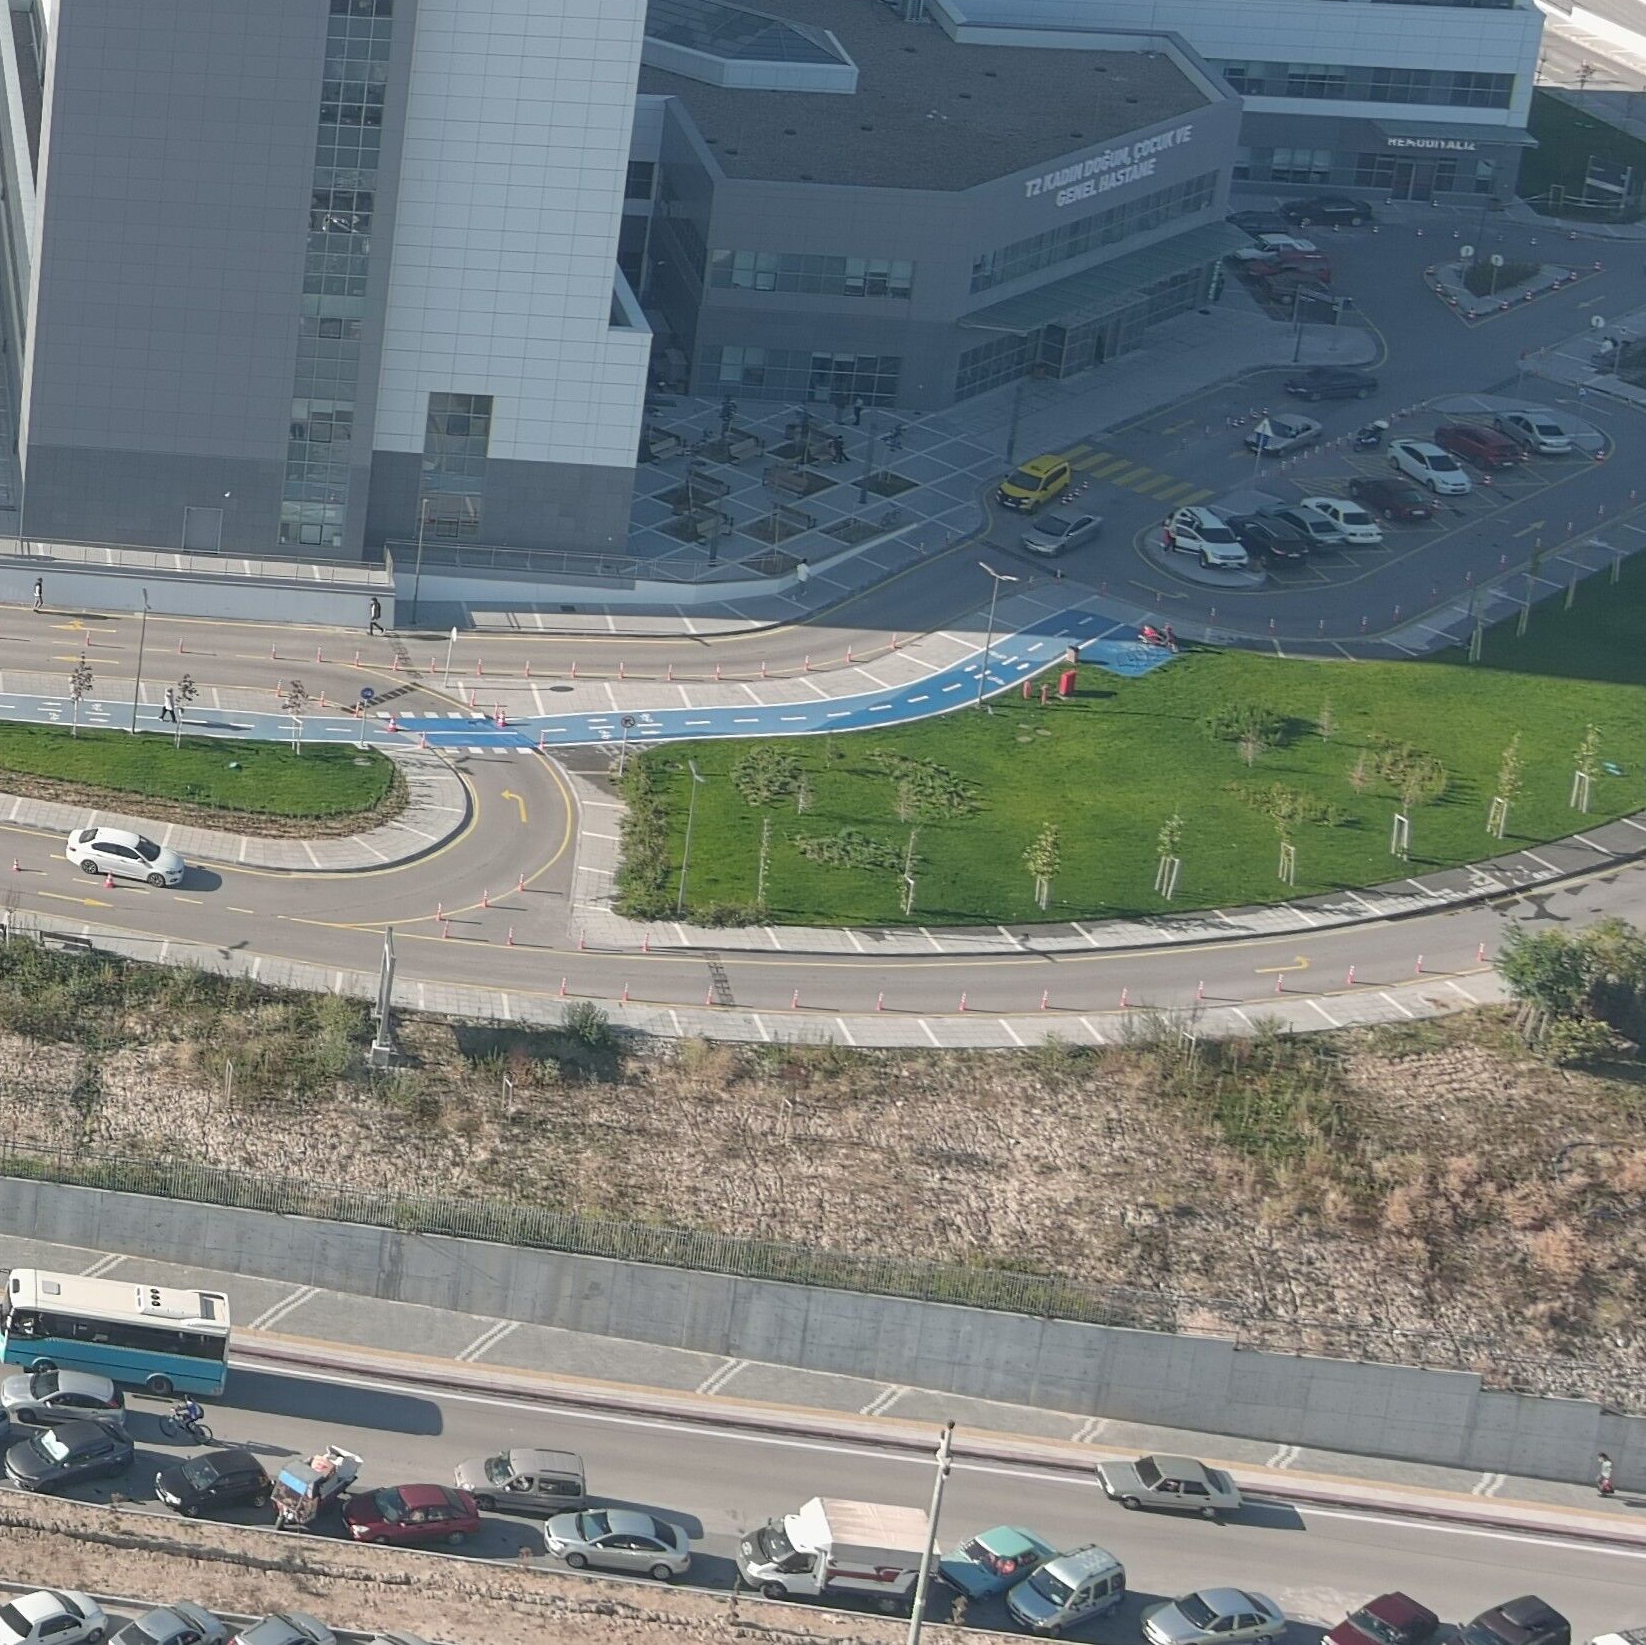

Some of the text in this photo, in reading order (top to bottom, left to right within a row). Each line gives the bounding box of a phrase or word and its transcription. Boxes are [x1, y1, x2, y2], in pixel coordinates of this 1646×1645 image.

[1043, 162, 1084, 192] KADIN
[1133, 130, 1174, 164] ÇOCUK
[1175, 124, 1194, 145] VE
[1056, 157, 1158, 207] GENEL HASTANE
